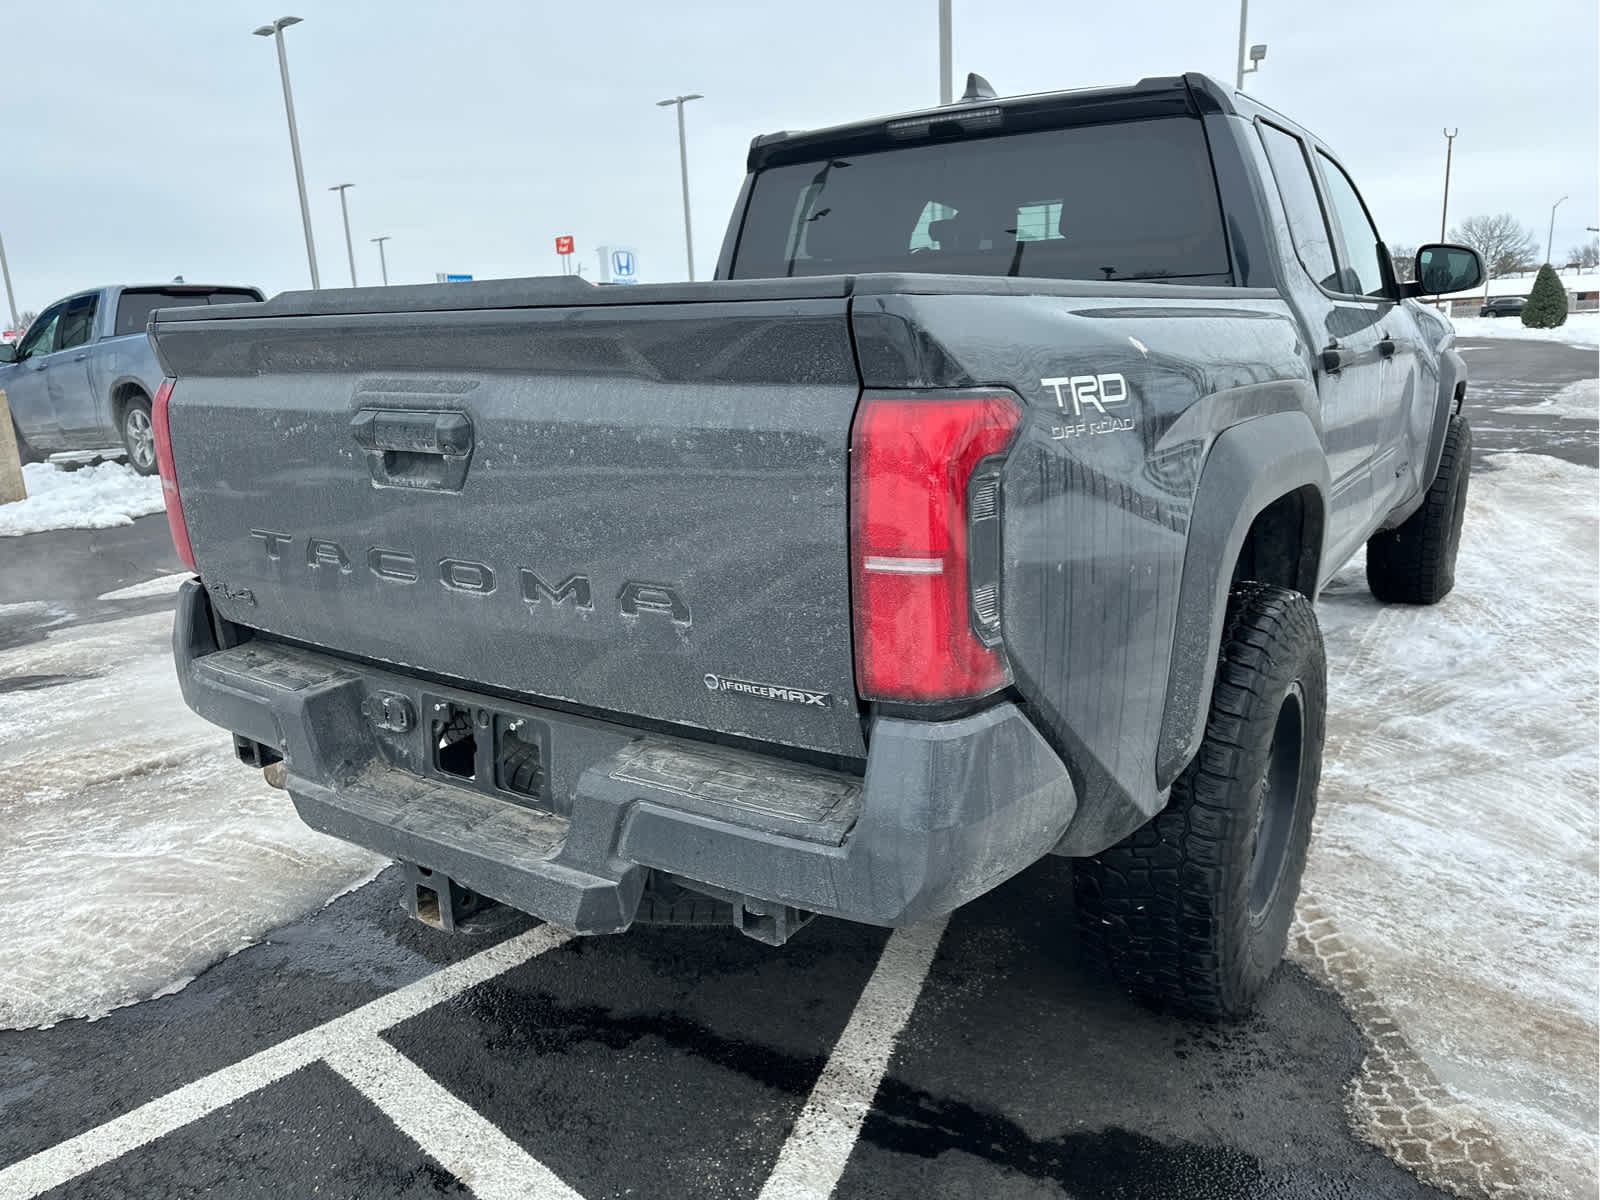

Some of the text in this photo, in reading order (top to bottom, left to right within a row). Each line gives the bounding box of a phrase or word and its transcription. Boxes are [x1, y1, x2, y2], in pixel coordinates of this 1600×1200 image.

[1040, 373, 1127, 416] TRD
[1051, 418, 1136, 440] OFF ROAD
[249, 527, 692, 628] TACOMA
